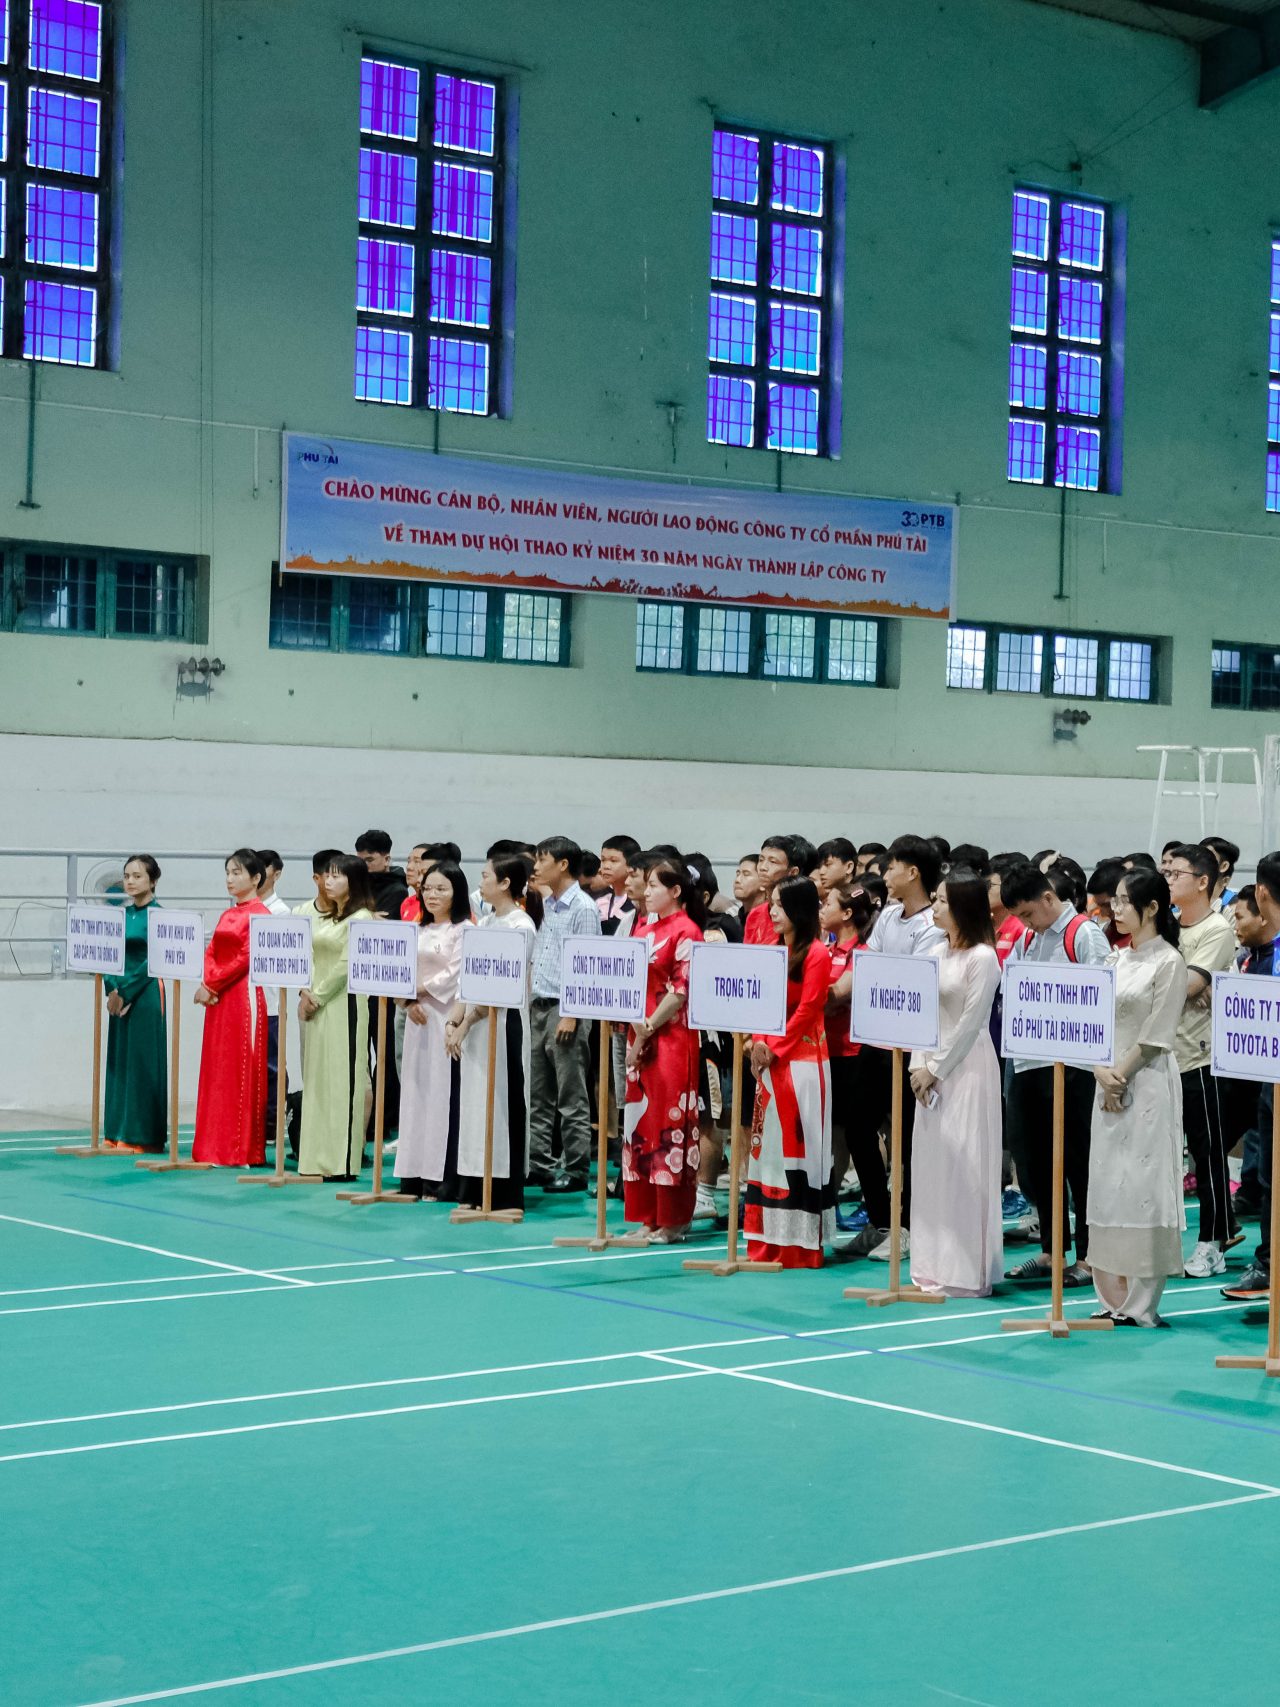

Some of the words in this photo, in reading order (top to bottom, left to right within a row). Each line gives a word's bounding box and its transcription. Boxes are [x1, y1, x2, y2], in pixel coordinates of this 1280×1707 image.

[325, 479, 374, 498] CHÀO
[380, 484, 431, 505] MỪNG
[438, 490, 472, 509] CÁN
[478, 494, 505, 514] BỘ,
[511, 498, 557, 517] NHÂN
[563, 503, 602, 522] VIÊN,
[608, 508, 658, 526] NGƯỜI
[663, 514, 691, 530] LAO
[696, 516, 738, 534] ĐỘNG
[744, 520, 786, 539] CÔNG
[790, 526, 807, 541] TY
[810, 524, 830, 542] CỔ
[834, 528, 872, 546] PHẦN
[906, 534, 927, 552] TÀI
[921, 513, 945, 527] PTB
[384, 524, 404, 542] VỀ
[410, 529, 457, 546] THAM
[462, 534, 484, 552] DỰ
[489, 534, 518, 554] HỘI
[524, 539, 568, 556] THAO
[573, 539, 593, 558] KỶ
[599, 544, 635, 564] NIỆM
[642, 550, 659, 563] 30
[664, 550, 698, 568] NĂM
[702, 554, 743, 572] NGÀY
[748, 558, 796, 576] THÀNH
[801, 562, 824, 580] LẬP
[828, 564, 866, 582] CÔNG
[871, 570, 886, 584] TY
[267, 932, 280, 949] QUAN
[282, 928, 296, 949] CÔNG
[298, 932, 304, 949] TY
[358, 933, 372, 954] CÔNG
[374, 938, 379, 955] TY
[381, 939, 394, 956] TNHH
[396, 939, 407, 957] MTV
[254, 953, 267, 974] CÔNG
[269, 957, 275, 974] TY
[361, 959, 371, 980] PHÚ
[382, 961, 399, 983] KHÁNH
[472, 954, 491, 980] NGHIỆP
[573, 950, 587, 974] CÔNG
[590, 956, 596, 975] TY
[597, 957, 611, 976] TNHH
[613, 958, 625, 976] MTV
[627, 950, 634, 978] GỖ
[566, 981, 576, 1005] PHÚ
[578, 981, 586, 1006] TÀI
[588, 980, 602, 1006] ĐỒNG
[604, 988, 613, 1008] NAI
[619, 990, 631, 1008] VINA
[715, 976, 744, 1002] TRỌNG
[747, 974, 760, 999] TÀI
[870, 982, 878, 1008] XÍ
[880, 985, 905, 1016] NGHIỆP
[908, 992, 921, 1013] 380
[1019, 977, 1040, 1002] CÔNG
[1044, 982, 1053, 1003] TY
[1056, 984, 1078, 1004] TNHH
[1081, 986, 1099, 1006] MTV
[1225, 992, 1254, 1019] CÔNG
[1259, 1000, 1272, 1021] TY
[1012, 1010, 1023, 1037] GỖ
[1026, 1014, 1042, 1039] PHÚ
[1045, 1015, 1057, 1040] TÀI
[1061, 1016, 1080, 1042] BÌNH
[1083, 1023, 1104, 1048] ĐỊNH
[1227, 1032, 1268, 1058] TOYOTA
